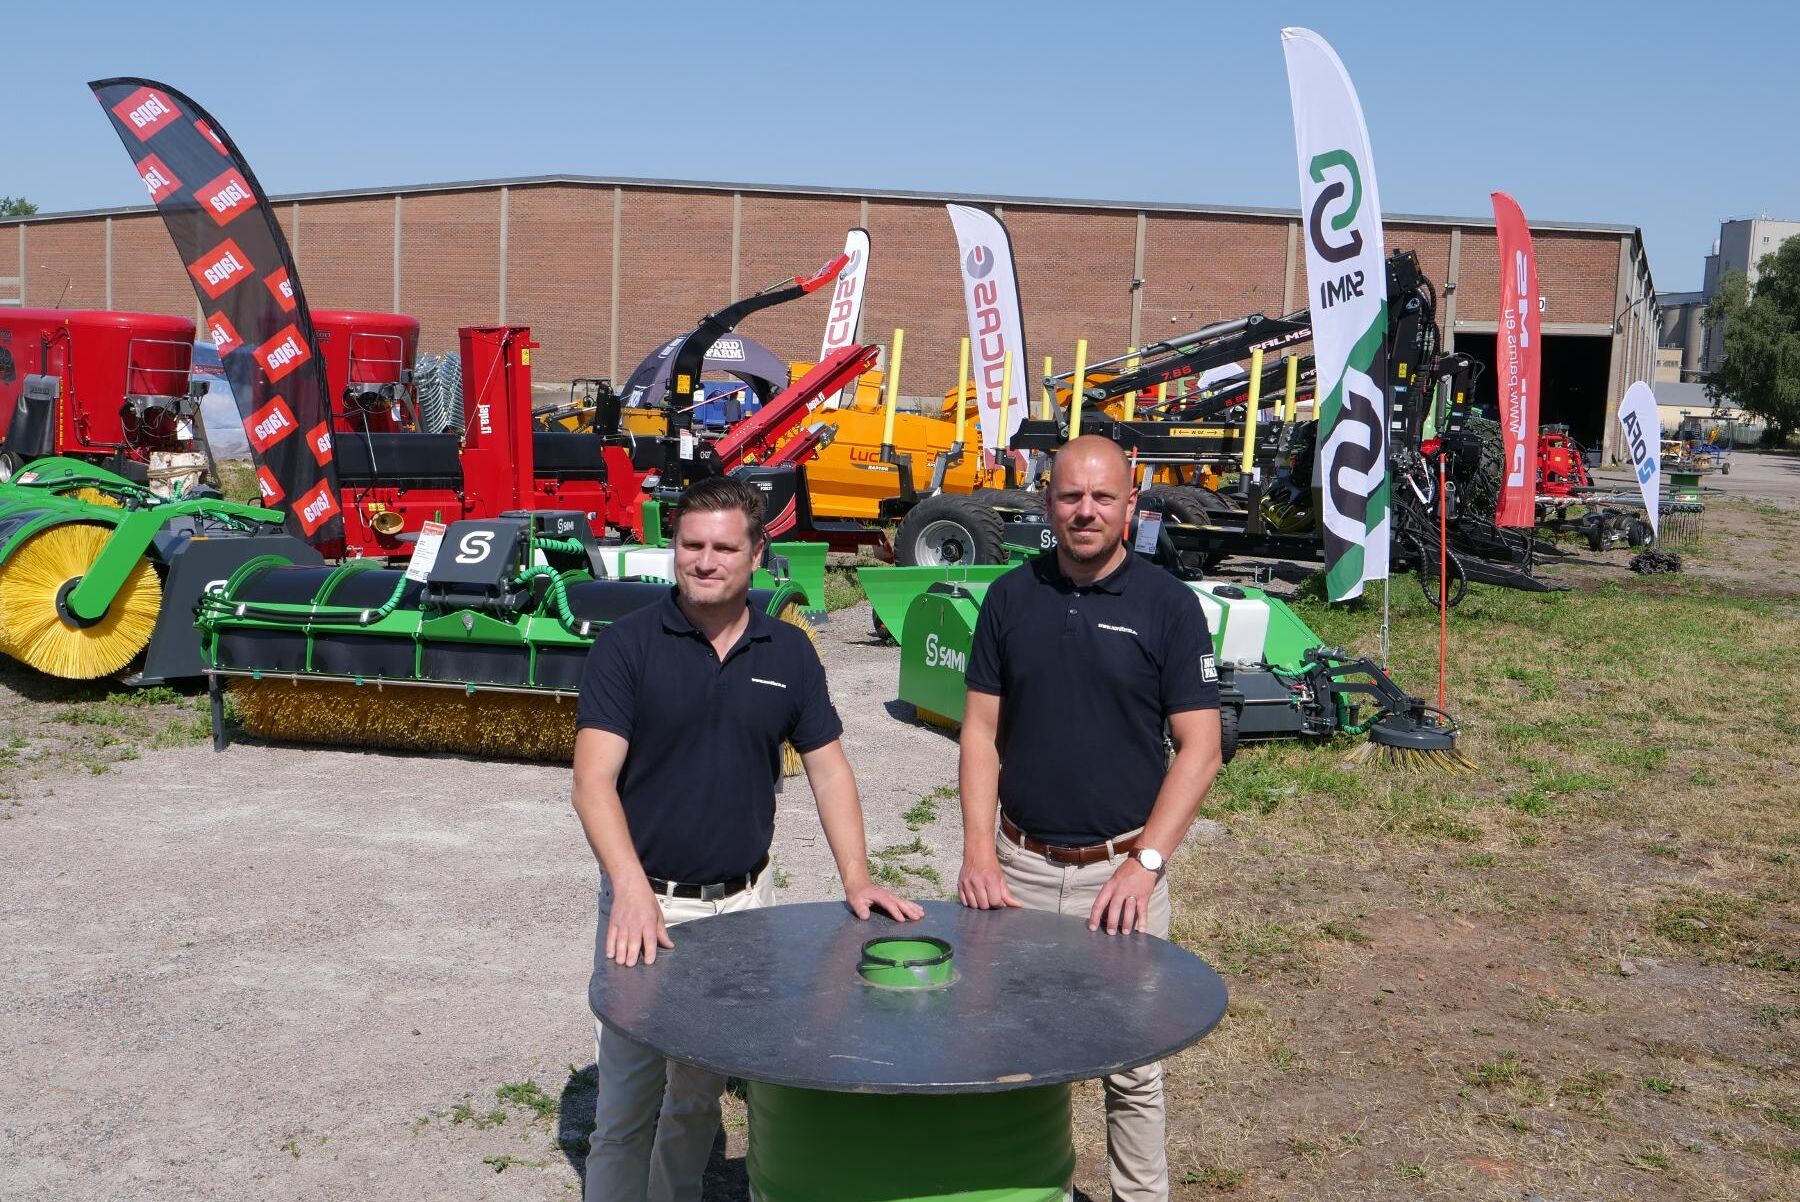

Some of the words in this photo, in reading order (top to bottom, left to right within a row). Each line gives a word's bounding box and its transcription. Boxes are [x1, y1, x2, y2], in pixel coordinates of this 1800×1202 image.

[710, 340, 740, 350] ORD
[1248, 328, 1312, 354] PALMS
[939, 646, 966, 673] SAMI
